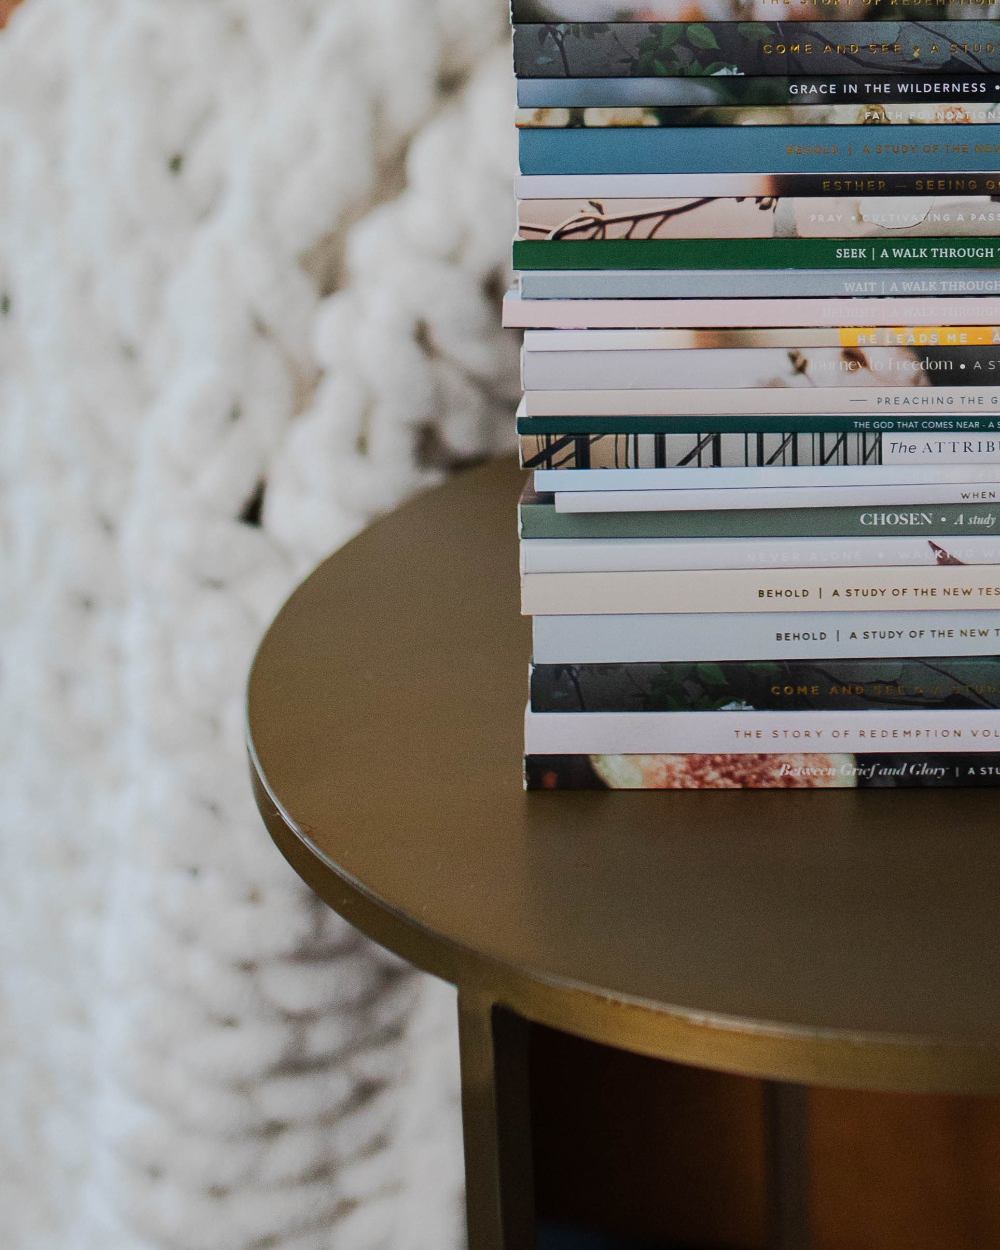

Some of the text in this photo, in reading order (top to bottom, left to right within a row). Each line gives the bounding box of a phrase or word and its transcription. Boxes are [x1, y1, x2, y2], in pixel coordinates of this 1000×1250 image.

[789, 84, 837, 94] GRACE
[843, 84, 858, 94] IN
[865, 84, 891, 94] THE
[897, 83, 986, 93] WILDERNESS
[836, 248, 867, 258] SEEK
[880, 248, 889, 258] A
[892, 248, 928, 258] WALK
[931, 248, 994, 258] THROUGH
[973, 361, 982, 370] A
[877, 397, 954, 405] PREACHING
[960, 396, 984, 404] THE
[890, 442, 917, 453] The
[960, 491, 996, 499] WHEN
[859, 512, 933, 525] CHOSEN
[954, 514, 964, 525] A
[968, 514, 997, 527] study
[758, 589, 810, 597] BEHOLD
[832, 589, 840, 597] A
[845, 588, 887, 597] STUDY
[892, 588, 908, 596] OF
[913, 588, 937, 596] THE
[943, 588, 973, 596] NEW
[776, 632, 827, 641] BEHOLD
[849, 631, 858, 639] A
[863, 630, 904, 639] STUDY
[909, 630, 925, 638] OF
[930, 629, 954, 638] THE
[959, 629, 990, 638] NEW
[734, 730, 763, 738] THE
[772, 730, 823, 738] STORY
[831, 729, 850, 738] OF
[859, 729, 962, 737] REDEMPTION
[779, 764, 837, 776] Between
[840, 763, 877, 779] Grief
[878, 763, 905, 776] and
[909, 763, 946, 778] Glory
[967, 767, 975, 775] A
